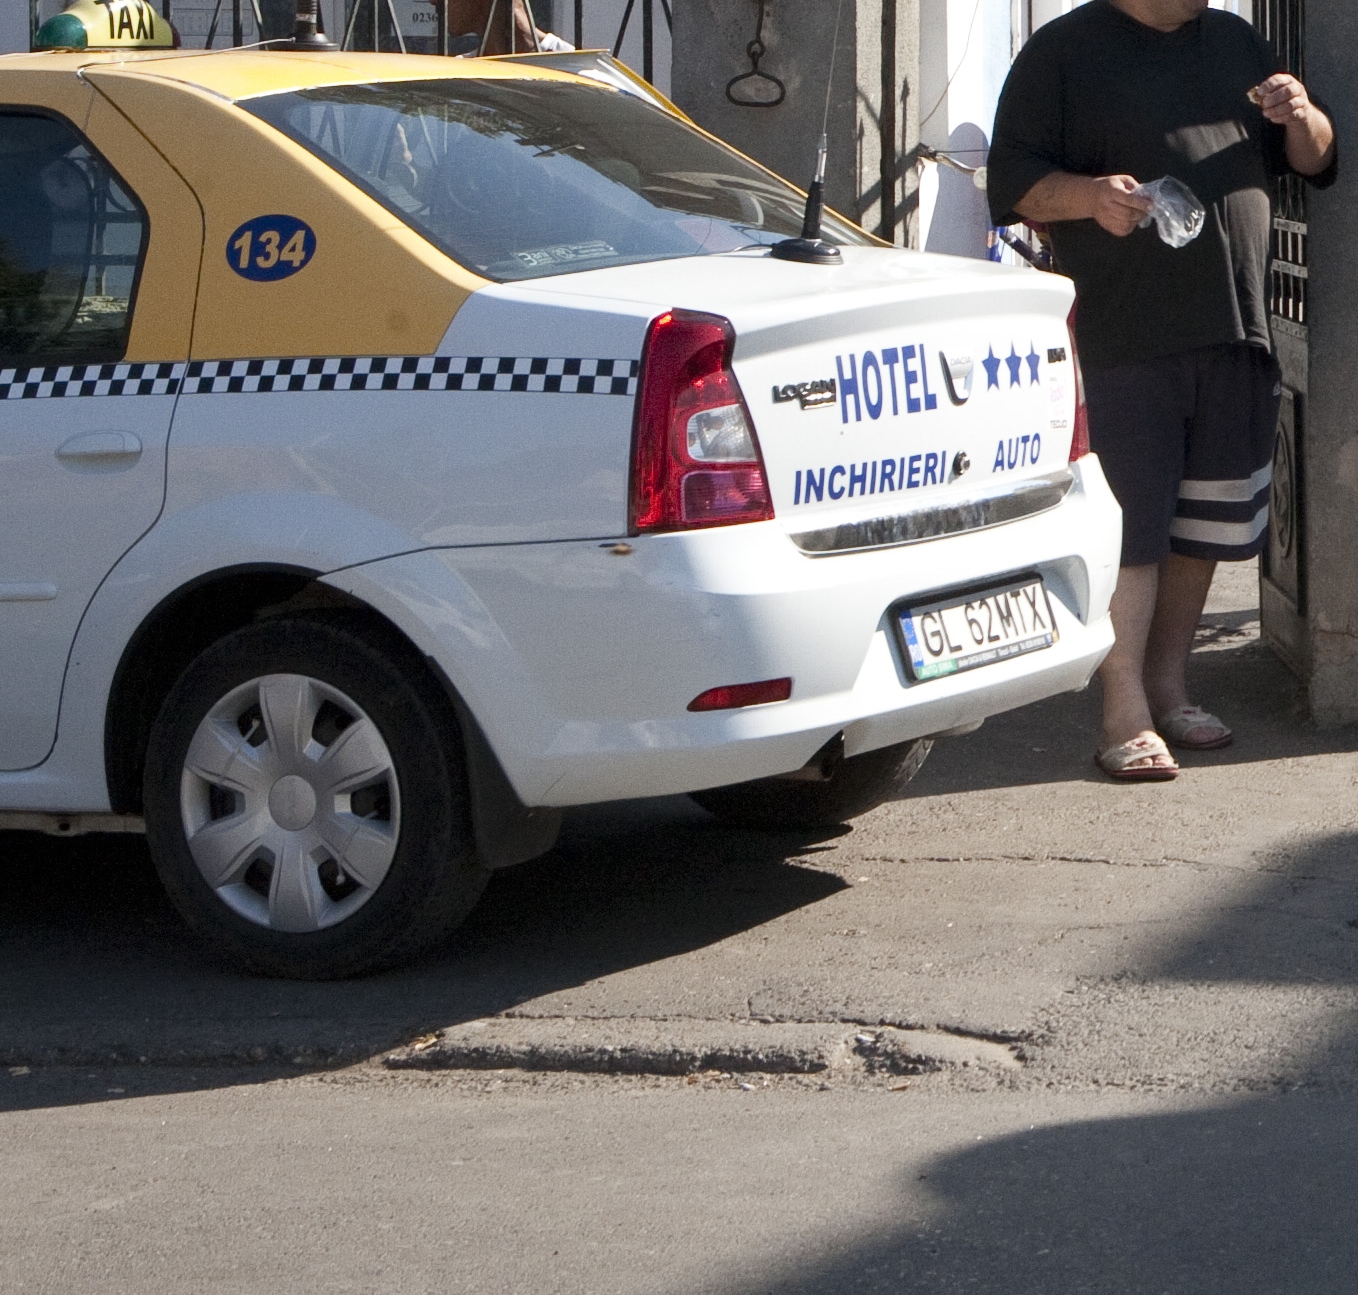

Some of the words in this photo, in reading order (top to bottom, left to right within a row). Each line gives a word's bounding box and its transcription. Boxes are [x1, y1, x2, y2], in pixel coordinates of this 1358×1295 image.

[233, 229, 306, 269] 134
[835, 343, 938, 425] HOTEL
[793, 450, 947, 506] INCHIRIERI
[992, 432, 1041, 474] AUTO
[920, 608, 963, 657] GL
